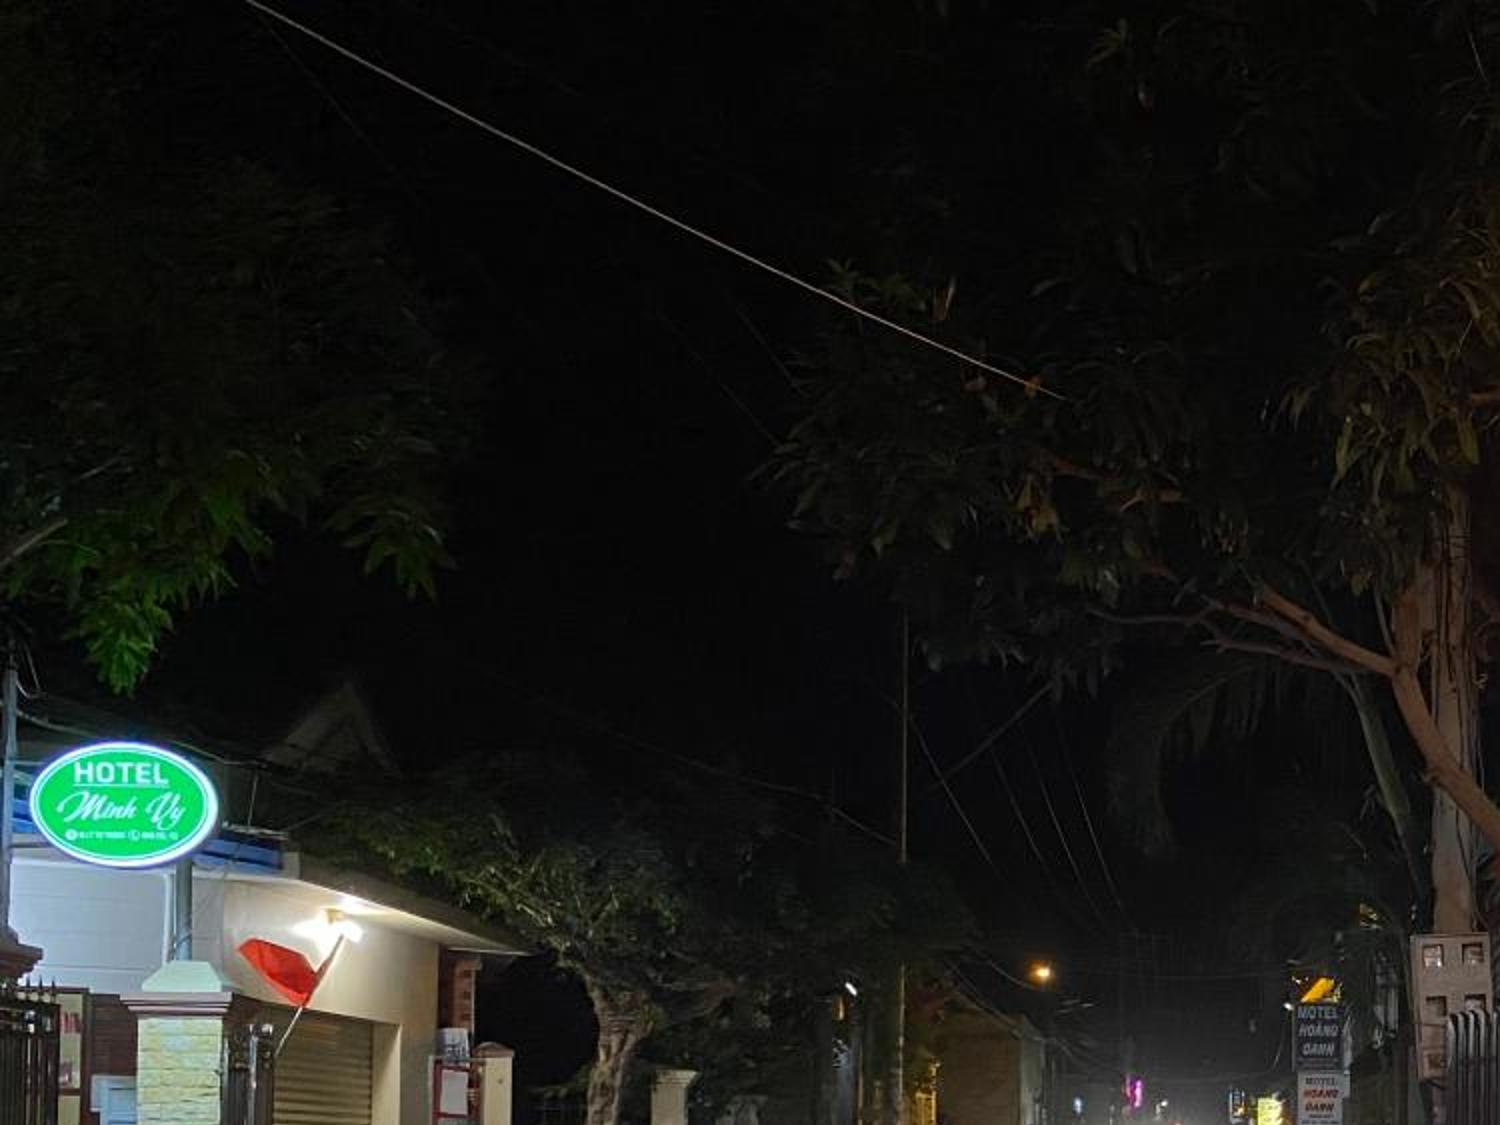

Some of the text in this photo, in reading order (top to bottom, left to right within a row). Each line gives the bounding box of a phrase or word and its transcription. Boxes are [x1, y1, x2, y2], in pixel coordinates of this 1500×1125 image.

[74, 761, 169, 784] HOTEL
[57, 791, 137, 822] Minh
[1298, 1006, 1338, 1018] MOTEL
